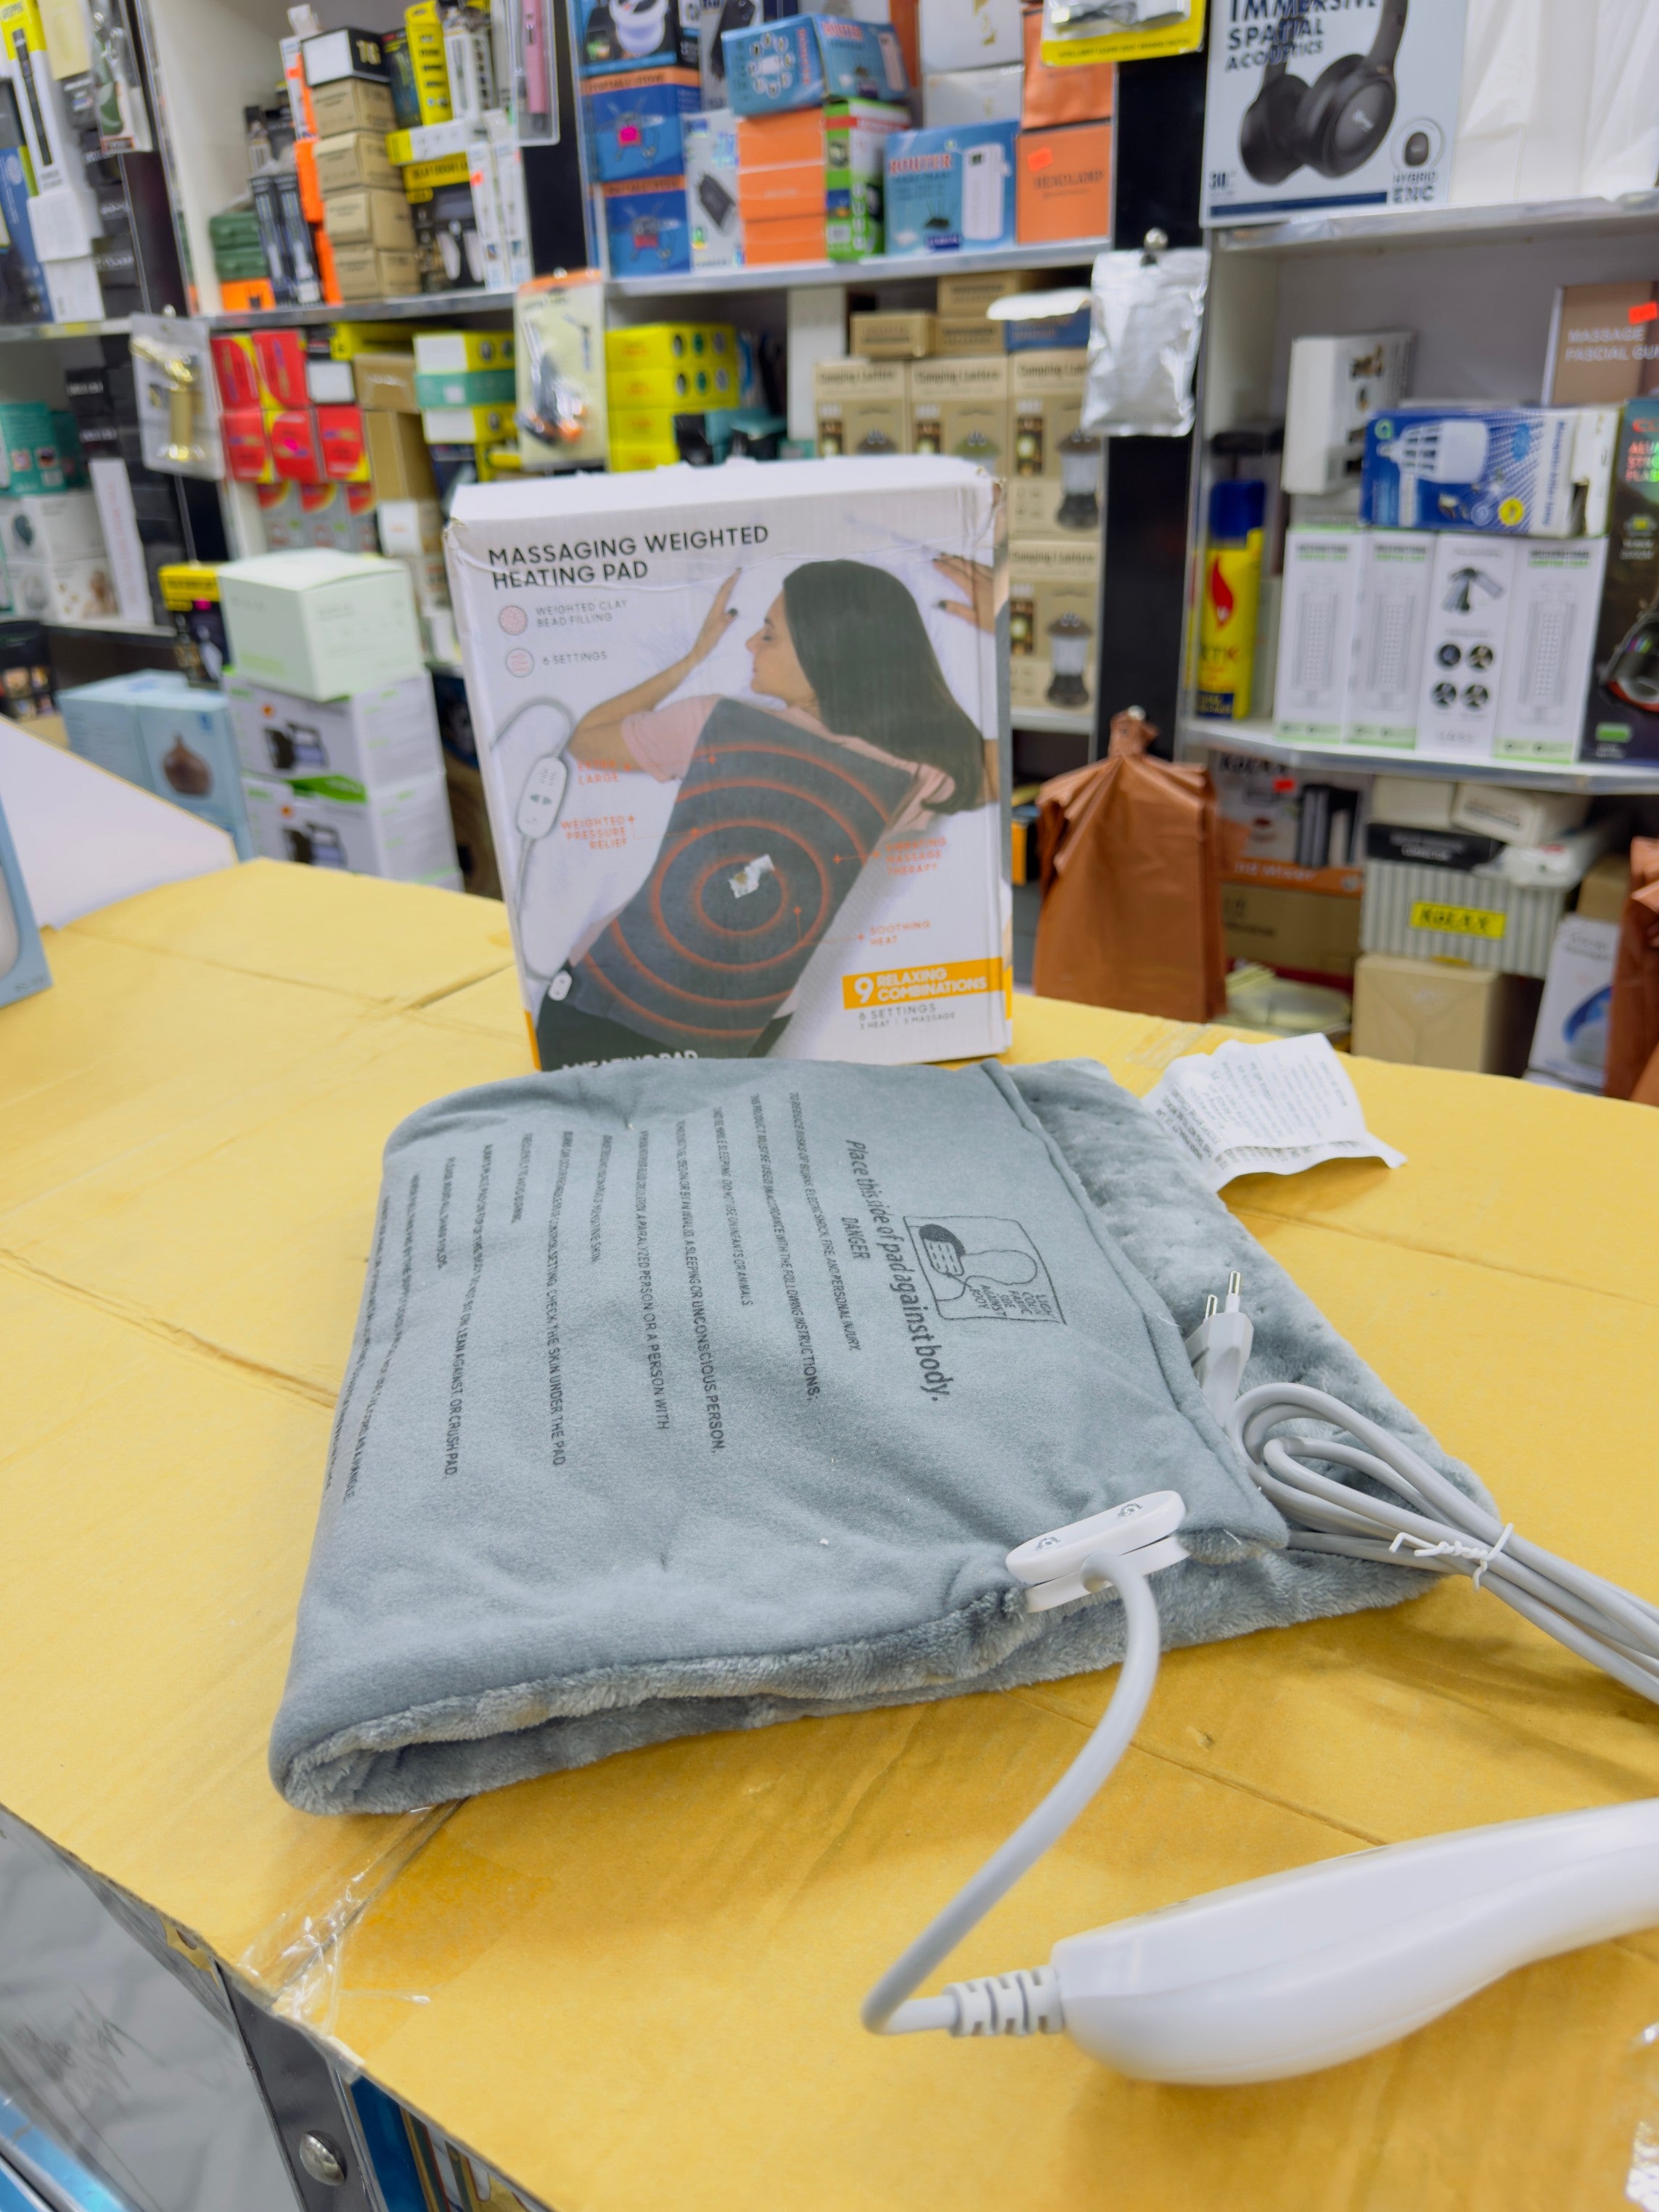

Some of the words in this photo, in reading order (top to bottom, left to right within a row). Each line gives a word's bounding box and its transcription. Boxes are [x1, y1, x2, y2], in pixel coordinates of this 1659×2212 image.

[1228, 19, 1325, 50] SPATIAL
[1393, 186, 1435, 203] ENC
[1568, 327, 1645, 343] MASSAGE
[488, 537, 638, 567] MASSAGING
[645, 525, 769, 554] WEIGHTED
[493, 564, 596, 591] HEATING
[603, 561, 649, 581] PAD
[536, 602, 596, 616] WEIGHTED
[599, 599, 628, 611] CLAY
[537, 617, 567, 628] BEAD
[553, 651, 608, 665] SETTINGS
[561, 815, 626, 830] WEIGHTED
[566, 827, 626, 840] PRESSURE
[853, 976, 874, 1004] 9
[876, 967, 948, 987] RELAXING
[877, 976, 987, 1001] COMBINATIONS
[871, 1003, 936, 1020] SETTINGS
[846, 1140, 867, 1175] Place
[856, 1178, 881, 1197] this
[867, 1199, 892, 1224] side
[841, 1217, 869, 1258] DANGER
[876, 1226, 904, 1240] of
[685, 1246, 700, 1285] SLEEPING
[877, 1242, 914, 1271] pad
[639, 1270, 652, 1310] PERSON
[783, 1269, 803, 1315] FOLLOWING
[832, 1274, 848, 1318] PERSONAL
[890, 1274, 933, 1341] against
[546, 1322, 559, 1345] THE
[643, 1313, 657, 1331] OR
[692, 1300, 716, 1392] UNCONSCIOUS
[548, 1348, 560, 1374] SKIN
[647, 1344, 663, 1396] PERSON
[915, 1345, 952, 1401] body.
[451, 1353, 464, 1398] AGAINST
[449, 1399, 462, 1414] OR
[549, 1375, 562, 1415] UNDER
[551, 1415, 564, 1441] THE
[655, 1399, 669, 1430] WITH
[446, 1415, 460, 1453] CRUSH
[552, 1441, 565, 1466] PAD
